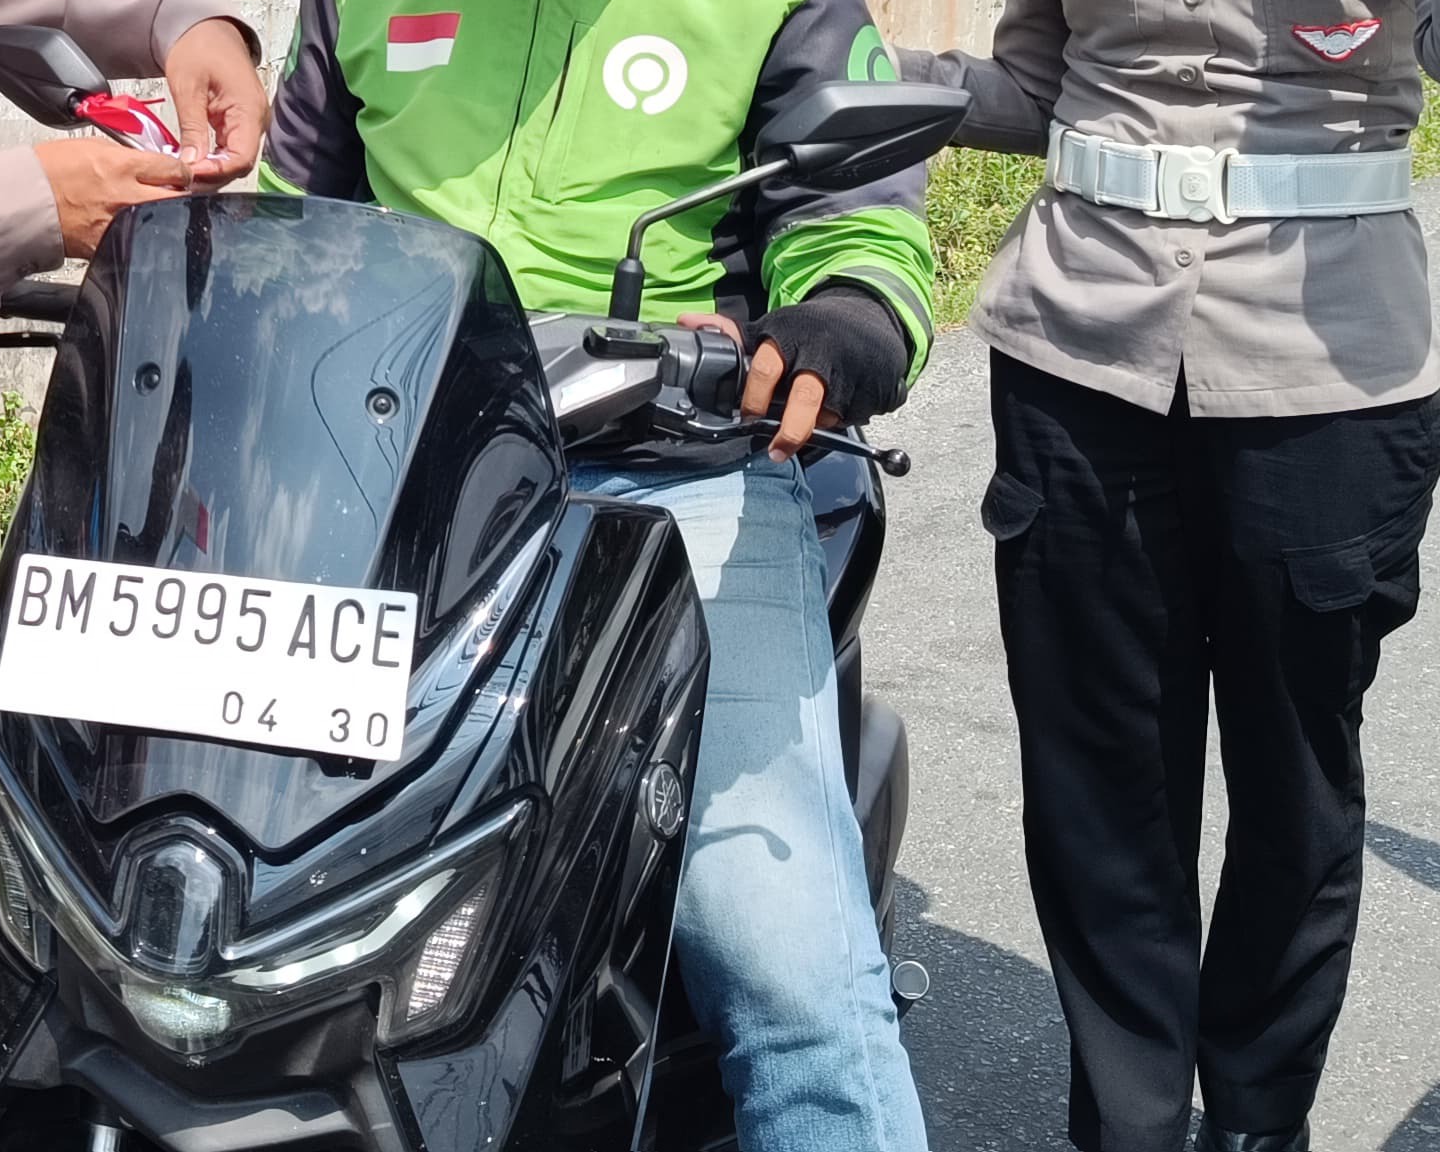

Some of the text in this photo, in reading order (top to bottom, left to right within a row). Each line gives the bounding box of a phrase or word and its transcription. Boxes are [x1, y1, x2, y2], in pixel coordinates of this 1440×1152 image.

[17, 565, 407, 669] BM 5995 ACE
[221, 691, 389, 748] 04 30
